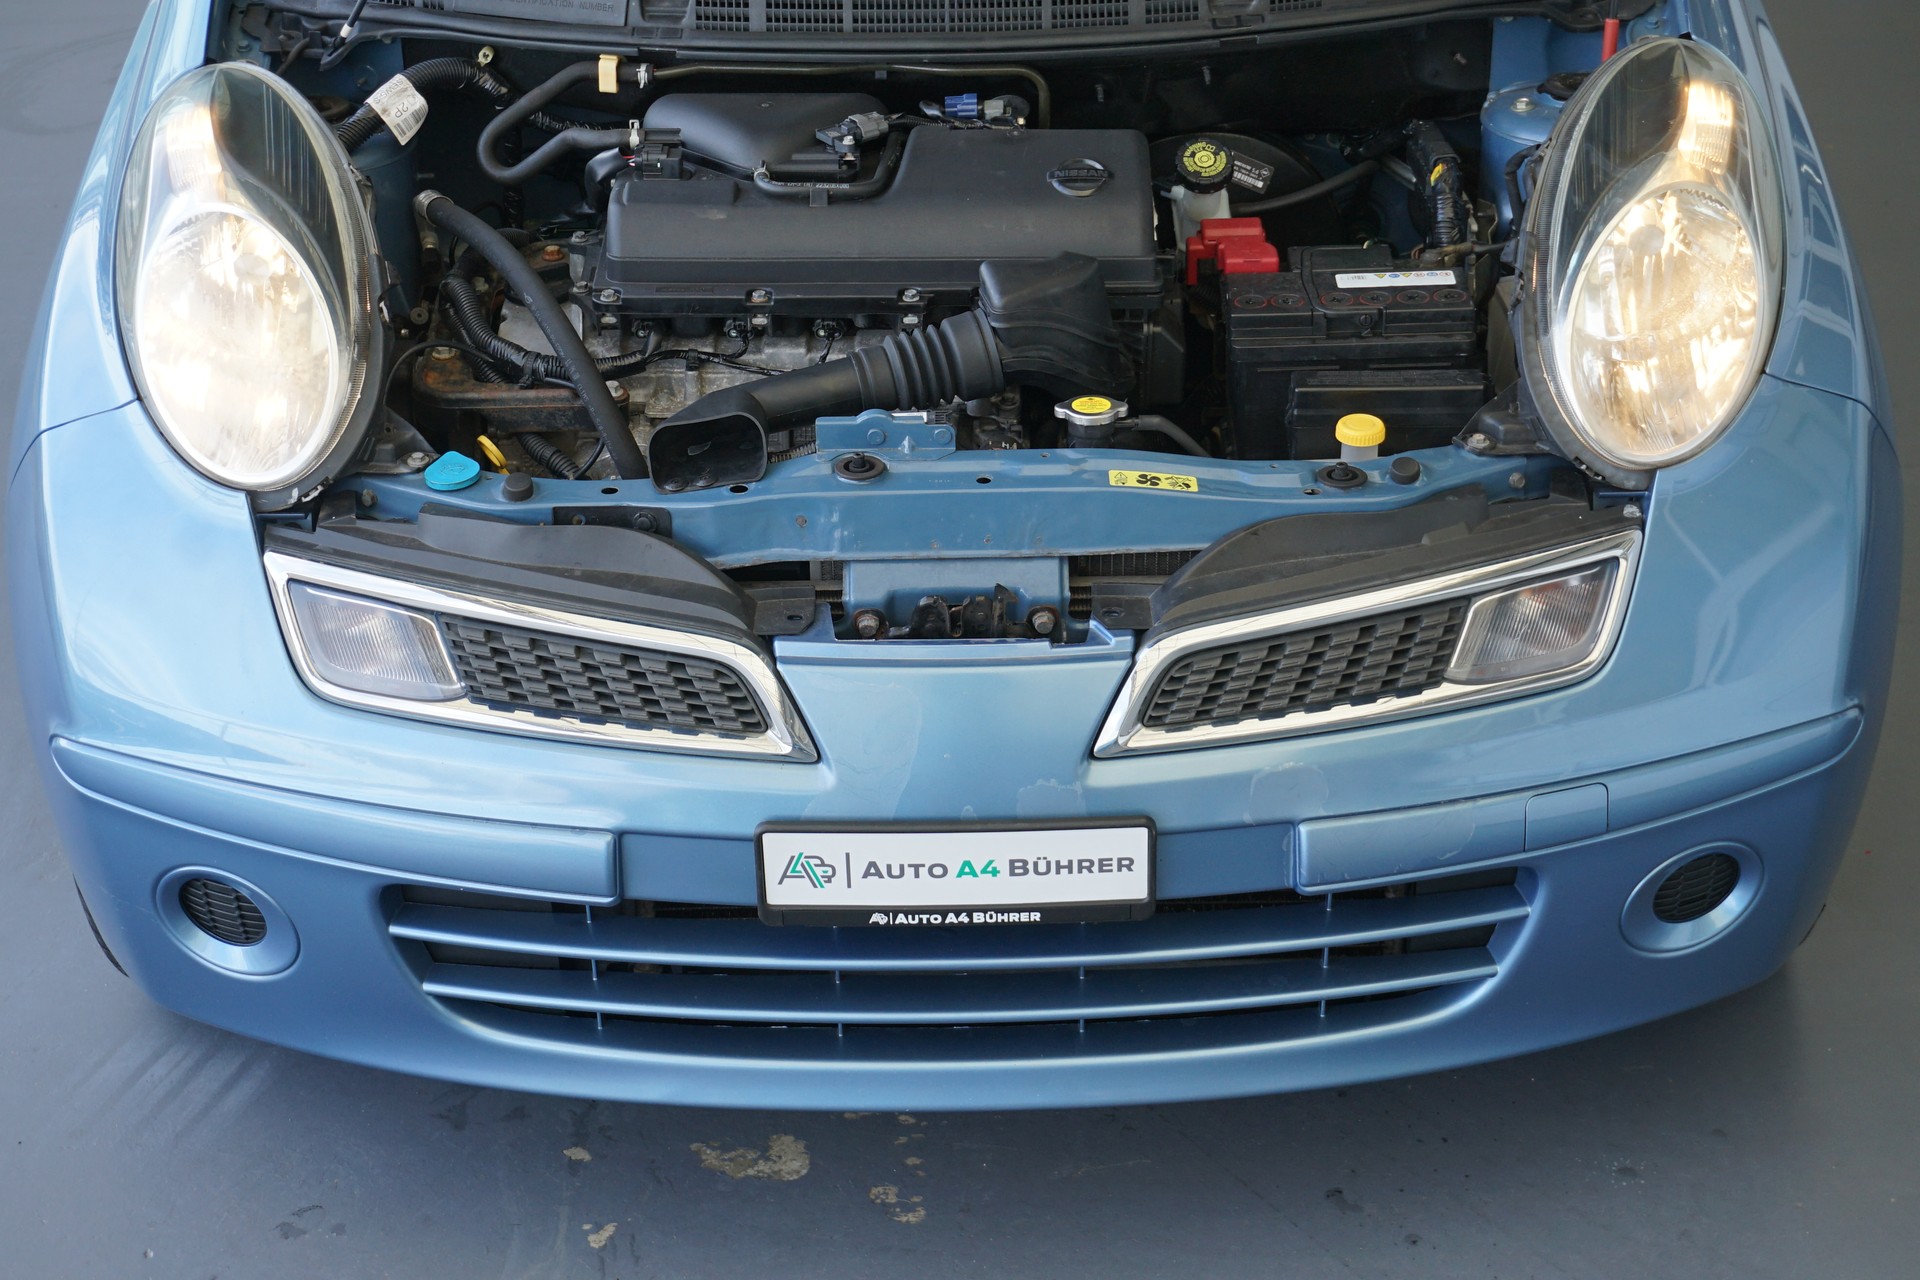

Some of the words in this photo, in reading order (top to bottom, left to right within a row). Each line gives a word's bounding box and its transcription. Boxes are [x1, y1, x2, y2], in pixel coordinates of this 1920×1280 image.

[578, 1, 614, 13] NUMBER
[1054, 169, 1108, 177] NISSAN
[861, 861, 949, 880] AUTO
[955, 858, 1000, 878] A4
[1009, 856, 1135, 877] BÜHRER
[895, 913, 942, 924] AUTO
[945, 912, 970, 924] A4
[973, 911, 1041, 923] BÜHRER
